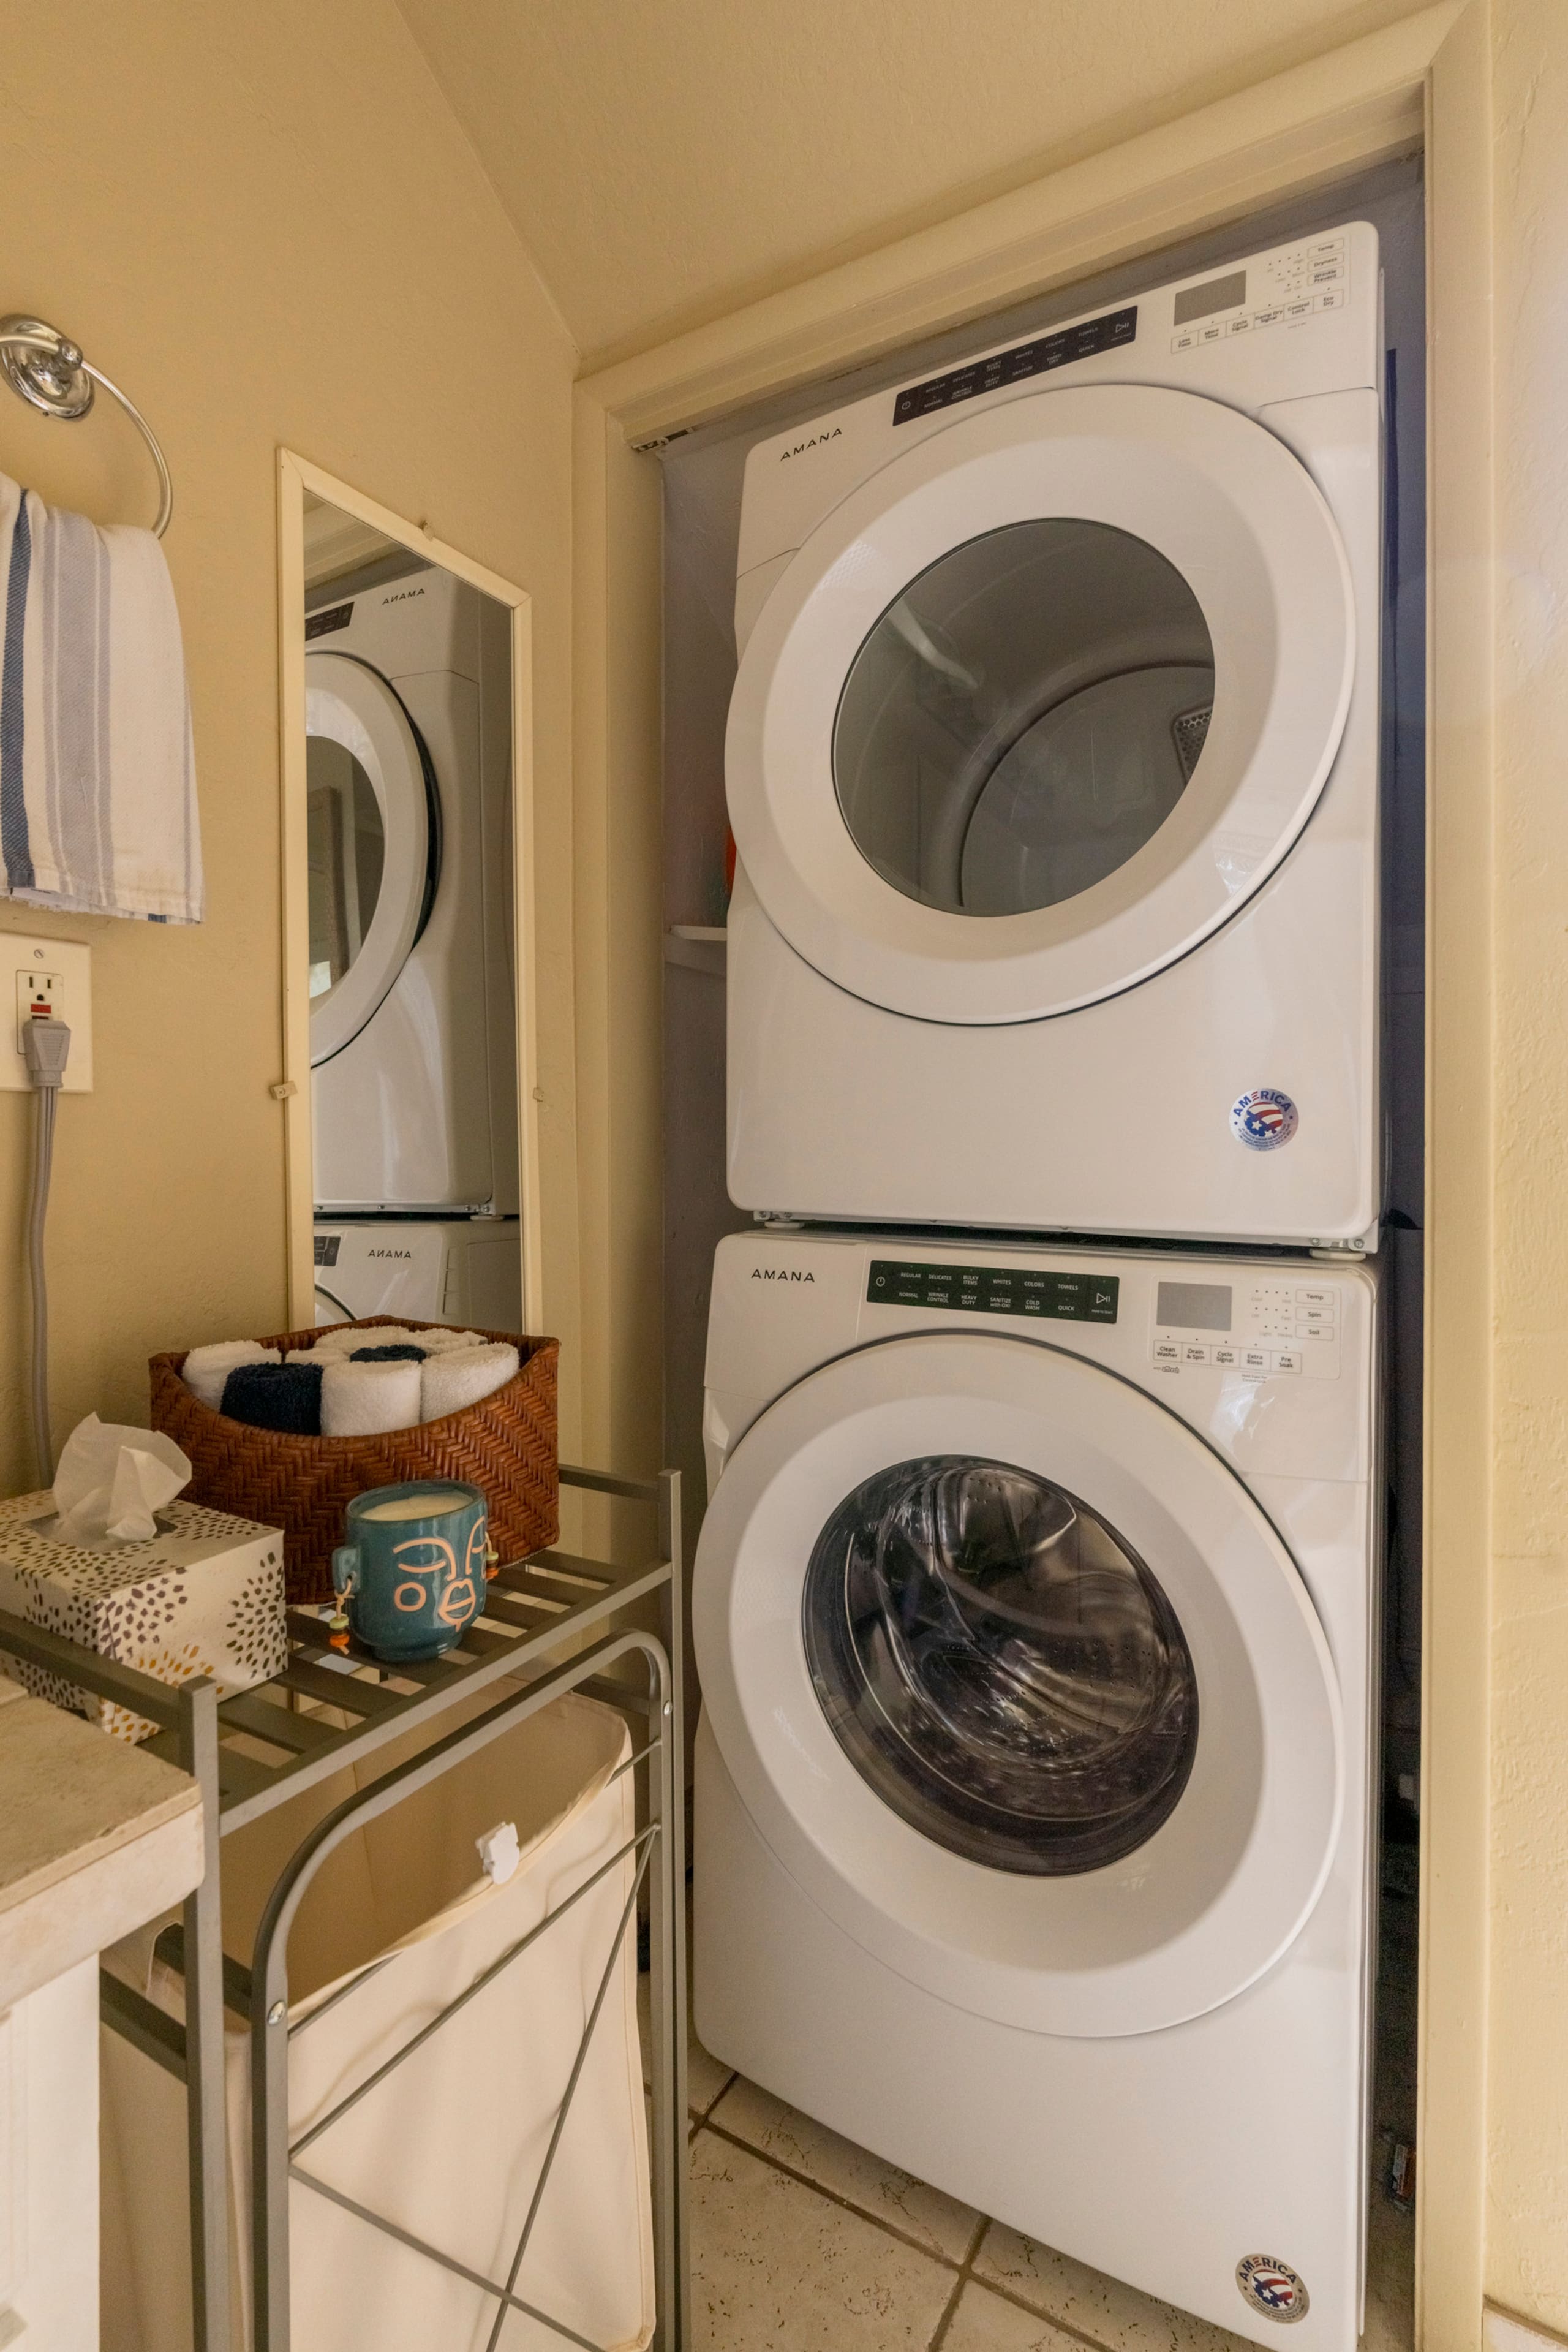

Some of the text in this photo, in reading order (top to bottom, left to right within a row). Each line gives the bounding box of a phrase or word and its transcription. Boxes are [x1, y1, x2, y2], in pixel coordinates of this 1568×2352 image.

[1314, 257, 1337, 267] Dryness
[1314, 270, 1336, 278] Wrinkle
[1314, 274, 1336, 283] Prevent
[1287, 301, 1310, 311] Control
[1079, 344, 1095, 353] QUICK
[780, 428, 843, 462] AMANA
[1233, 1090, 1292, 1118] AMERICA
[751, 1269, 815, 1283] AMANA
[1238, 2256, 1297, 2285] AMERICA
